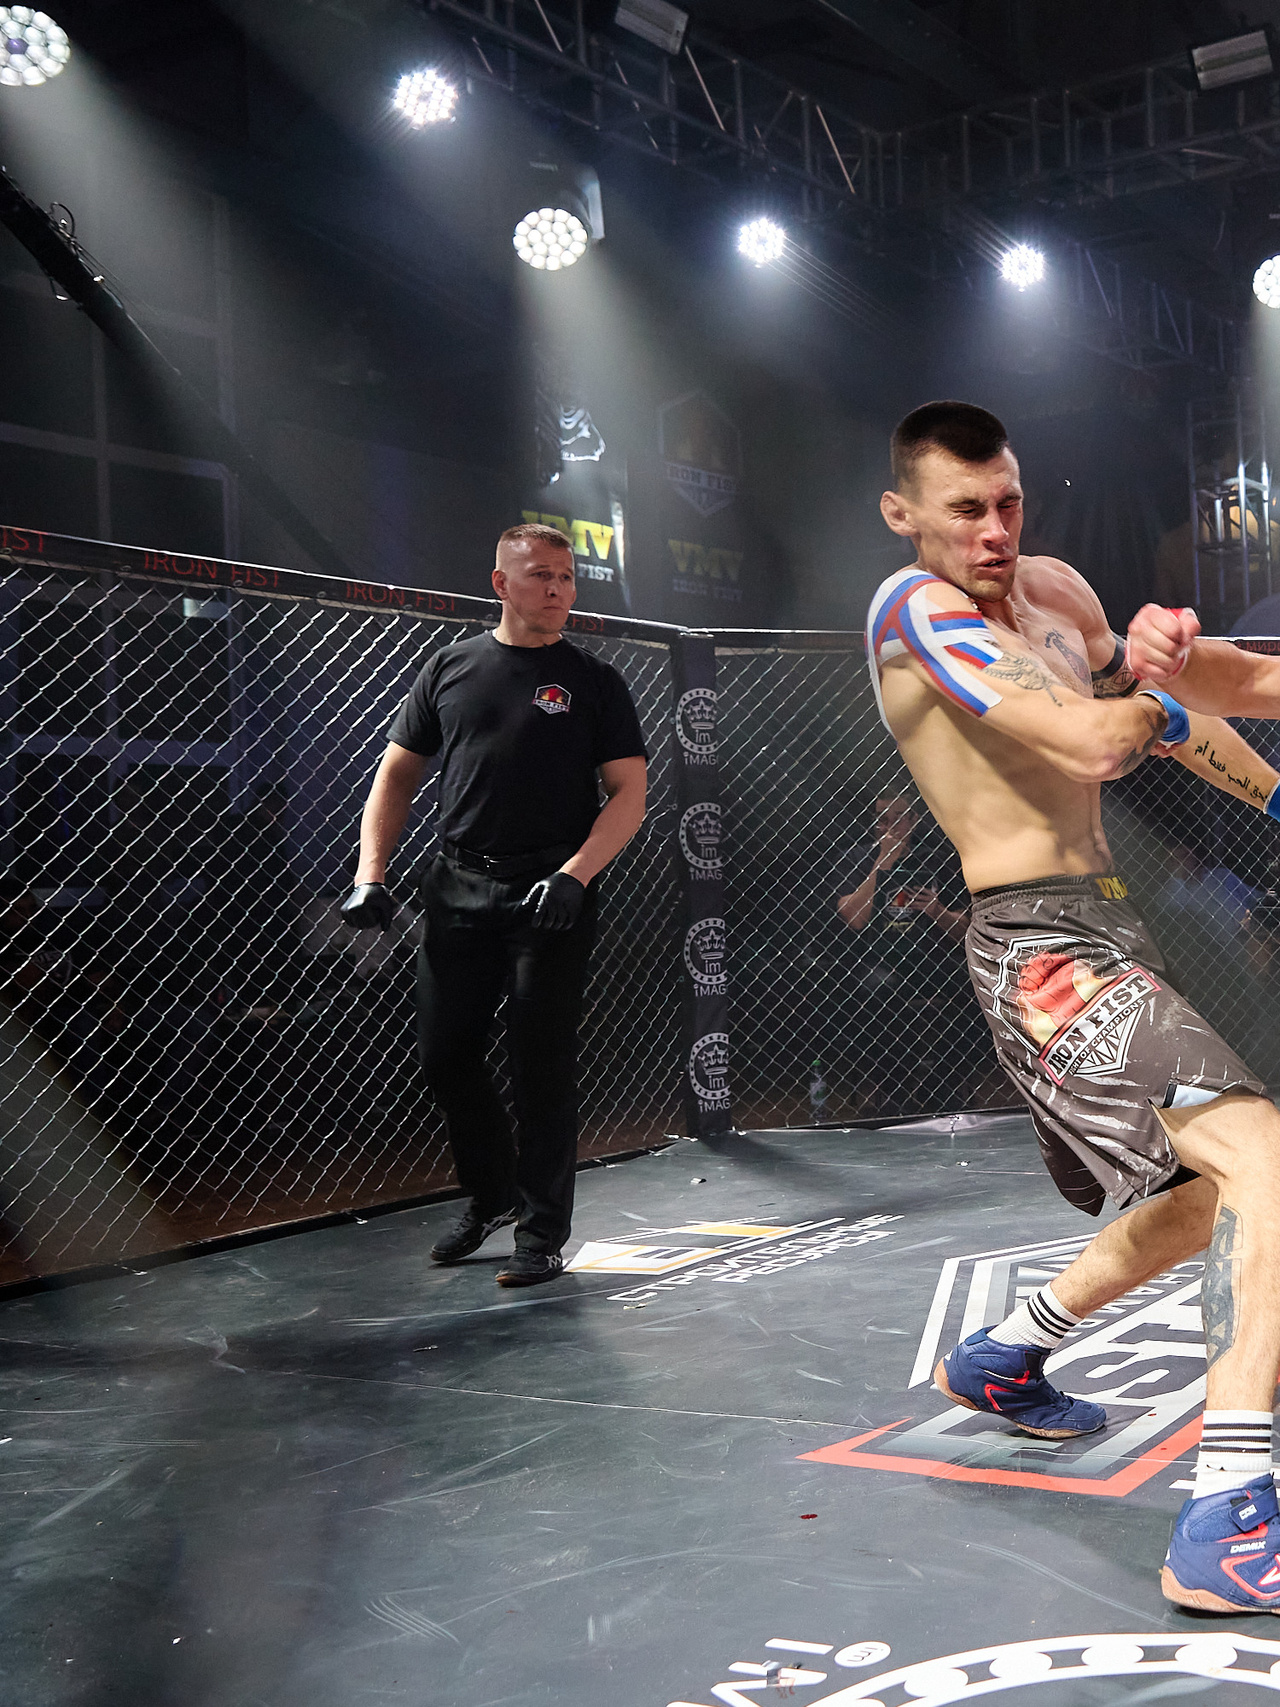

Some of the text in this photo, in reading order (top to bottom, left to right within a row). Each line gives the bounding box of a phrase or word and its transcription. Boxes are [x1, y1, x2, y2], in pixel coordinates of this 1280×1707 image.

[144, 552, 217, 579] IRON
[576, 562, 614, 582] FIST
[345, 582, 405, 606] IRON
[1048, 975, 1147, 1075] IRON FIST
[1080, 1047, 1091, 1059] OF
[1091, 998, 1145, 1047] CHAMPIONS
[606, 1213, 905, 1301] СТРОИТЕЛЬНЫЕ
[711, 1230, 896, 1283] РЕСУРСЫ
[1230, 1541, 1266, 1554] DEMIX
